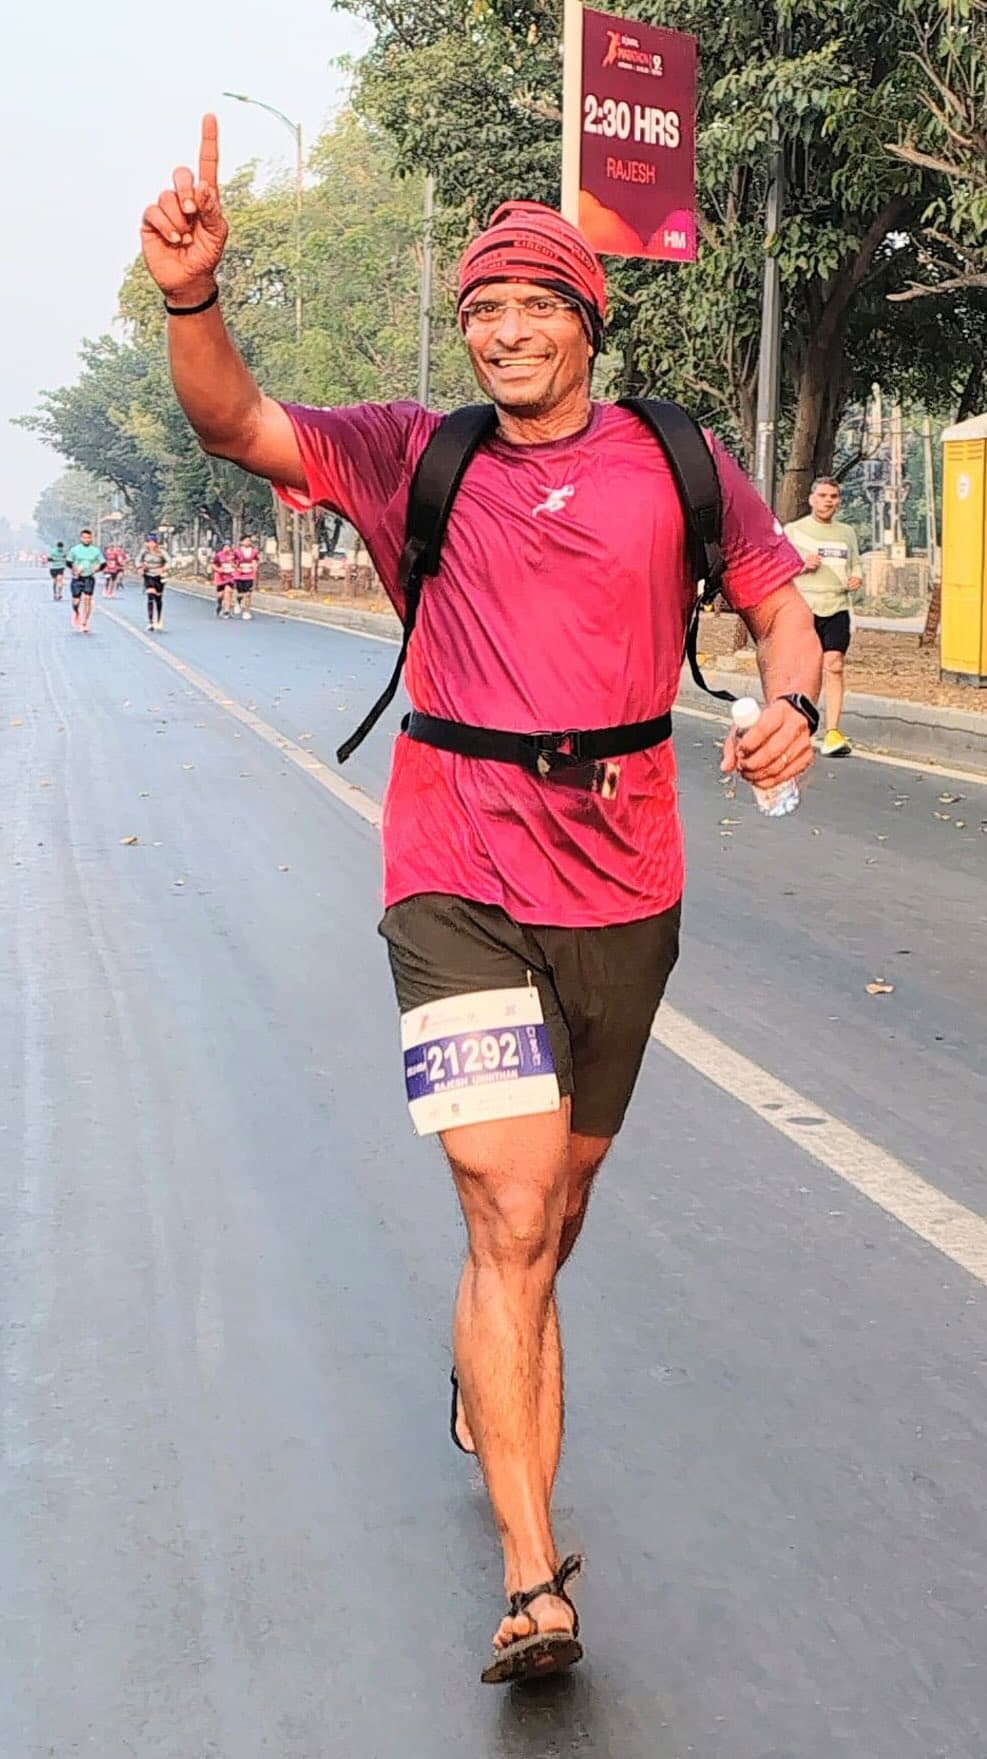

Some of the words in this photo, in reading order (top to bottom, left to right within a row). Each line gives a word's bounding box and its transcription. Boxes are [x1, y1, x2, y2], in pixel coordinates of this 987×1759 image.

[584, 94, 631, 139] 2:30
[634, 105, 680, 149] HRS
[607, 157, 656, 184] RAJESH
[663, 229, 687, 249] HM
[427, 1032, 519, 1081] 21292
